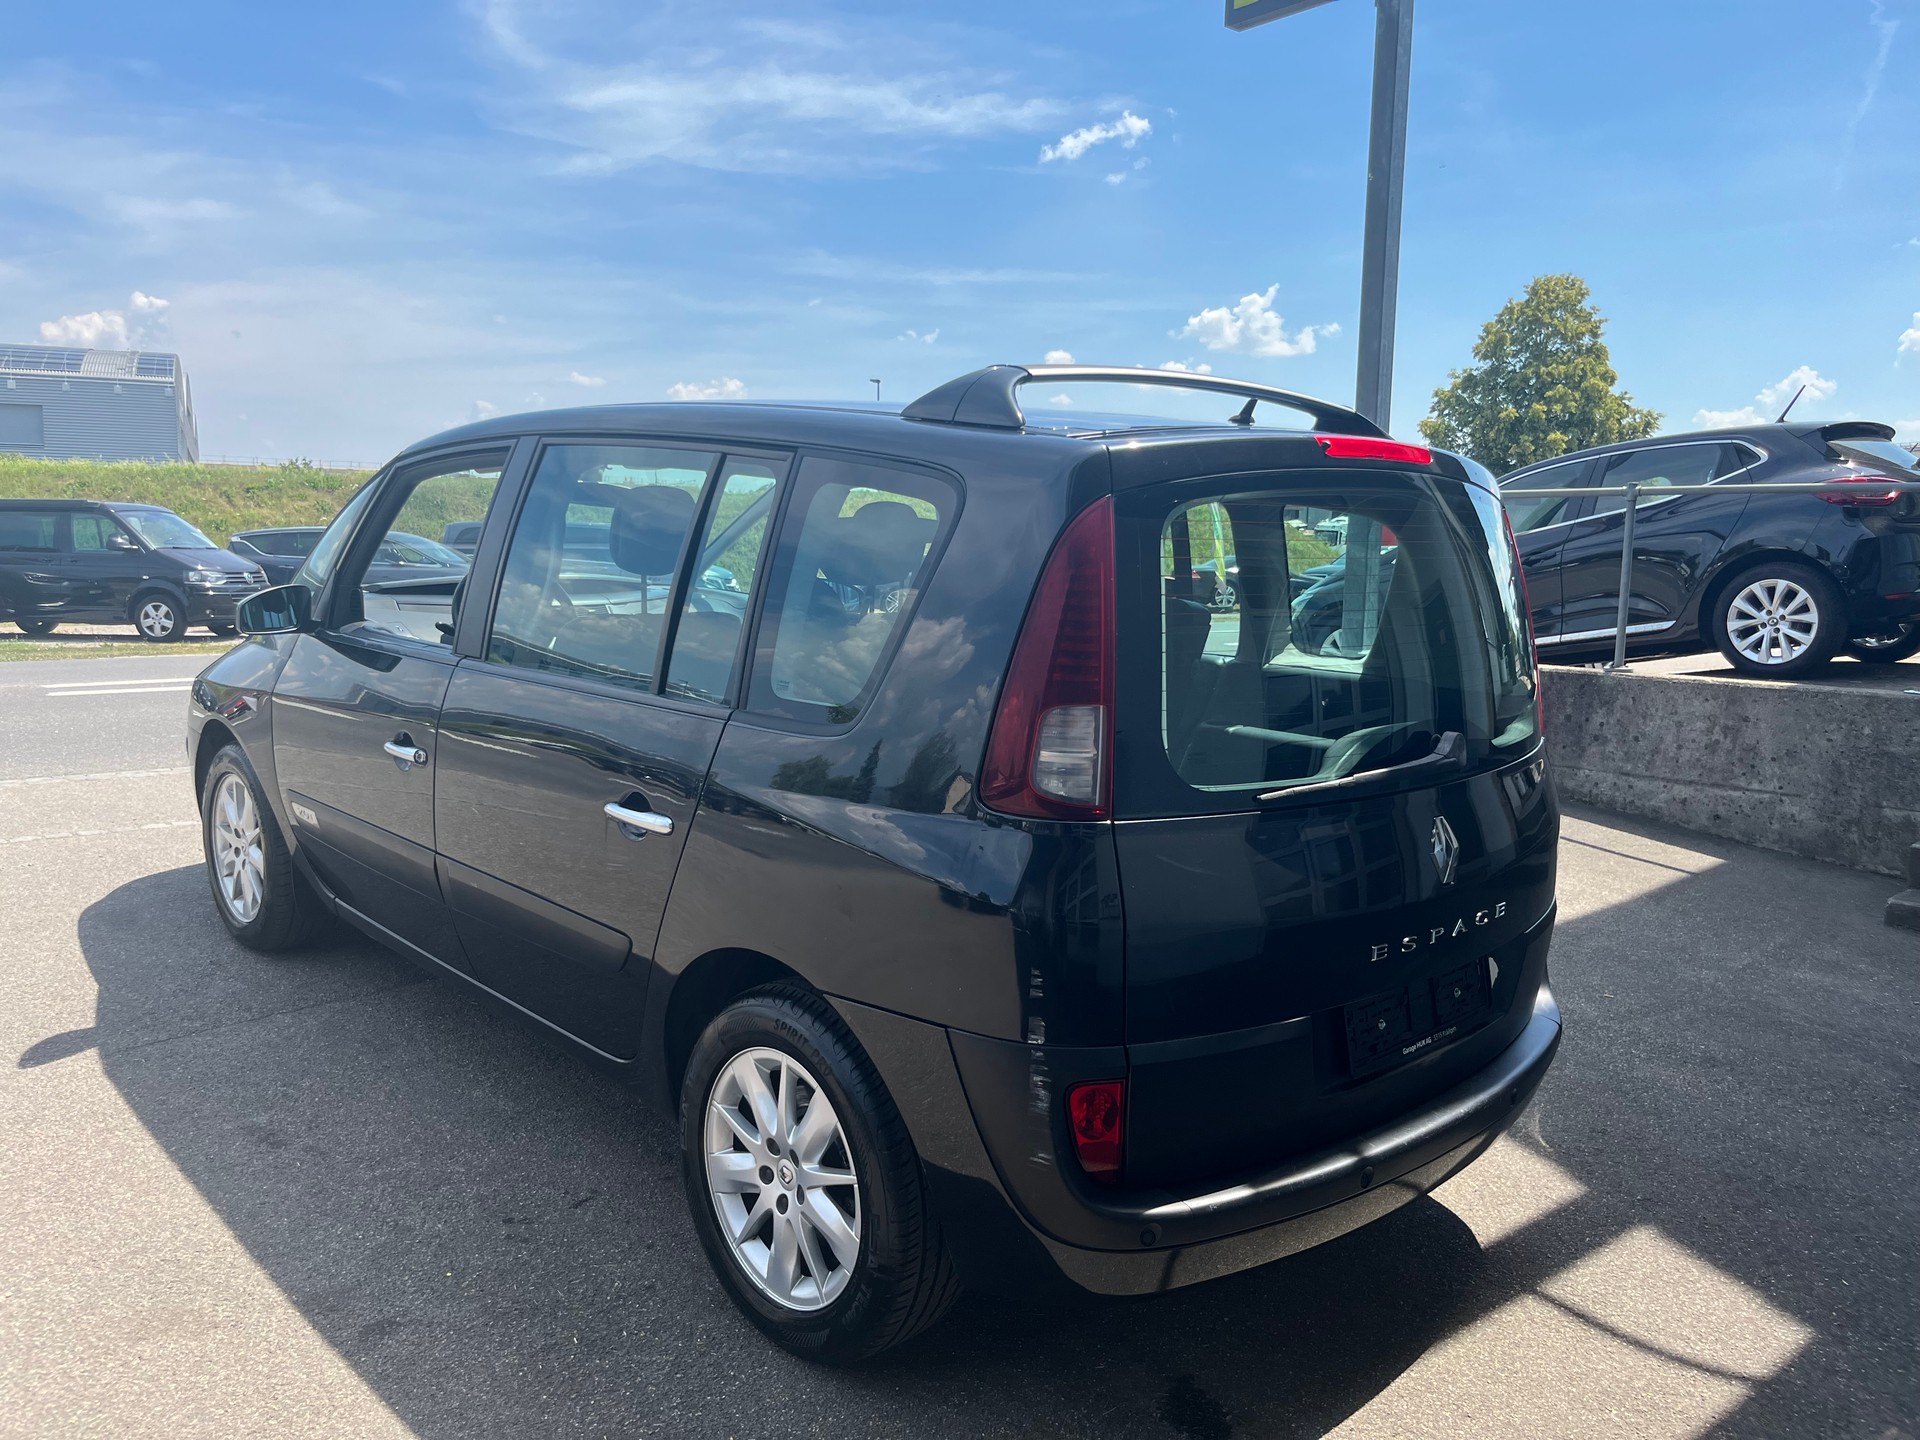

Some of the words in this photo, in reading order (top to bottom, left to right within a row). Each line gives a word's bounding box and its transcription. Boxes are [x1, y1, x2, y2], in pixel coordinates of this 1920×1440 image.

[1371, 902, 1506, 961] ESPACE
[772, 1018, 810, 1048] SPIRIT
[1402, 1045, 1416, 1055] Garage
